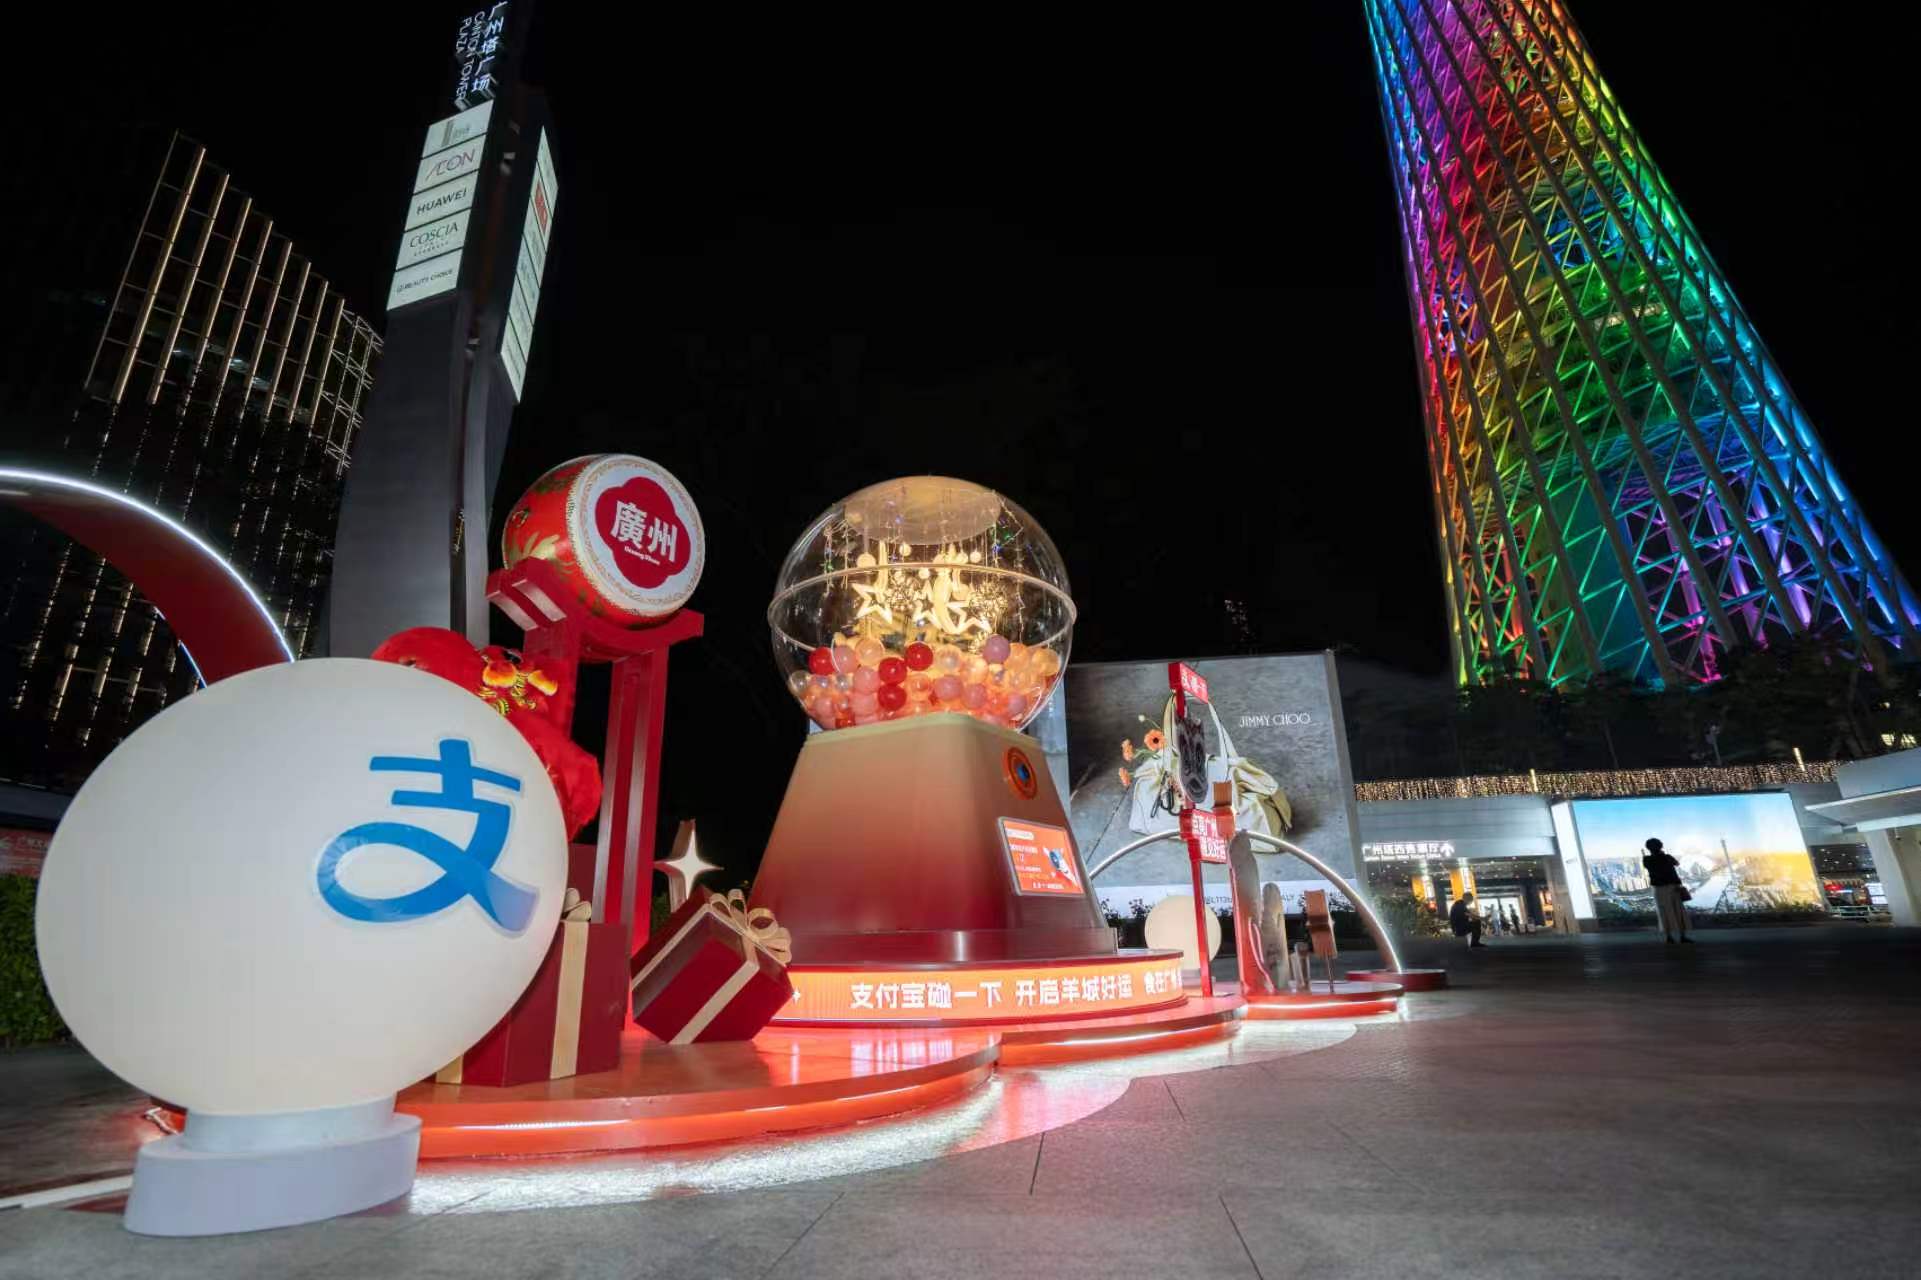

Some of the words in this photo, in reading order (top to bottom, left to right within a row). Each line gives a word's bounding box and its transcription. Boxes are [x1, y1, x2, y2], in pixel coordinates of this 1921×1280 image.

[416, 187, 467, 215] HUAWEI
[409, 221, 458, 248] COSCIA
[610, 500, 678, 562] 廣州
[1239, 713, 1271, 729] JIMMY
[1272, 711, 1312, 727] CHOO
[849, 980, 1003, 1009] 支付宝碰一下
[1015, 973, 1134, 1007] 开启羊城好运
